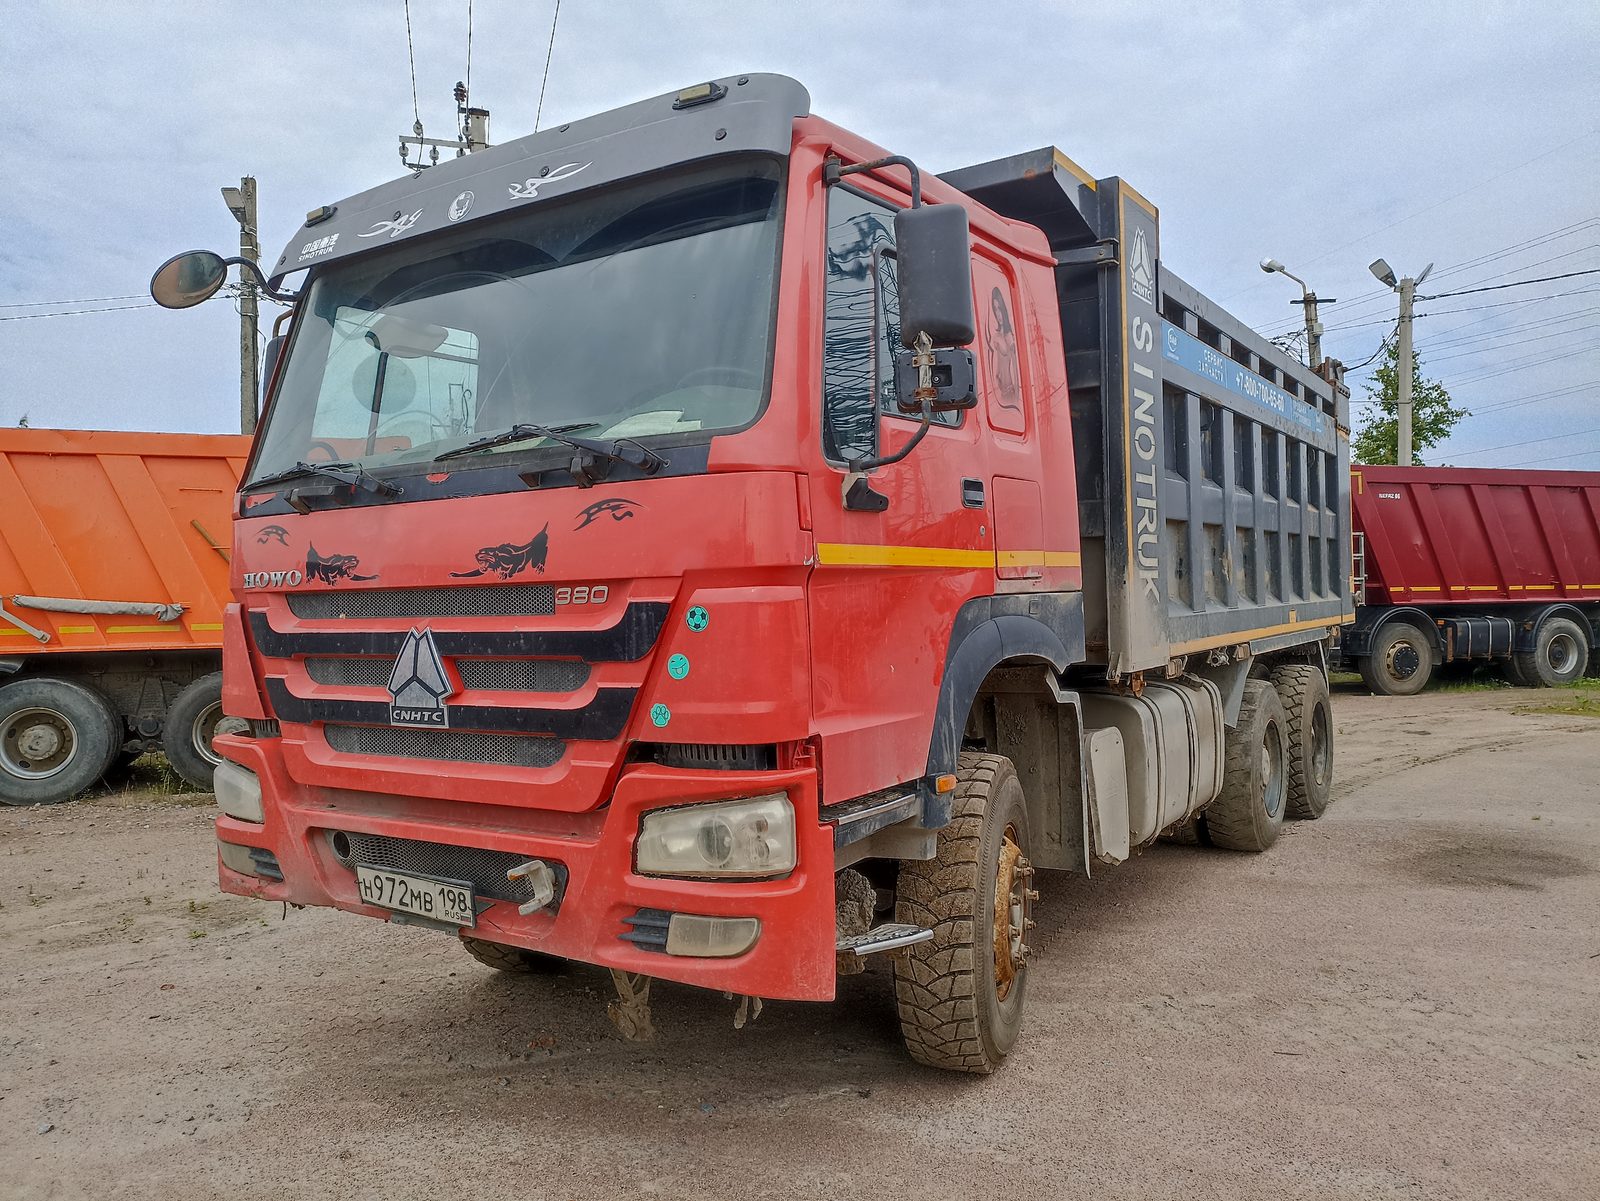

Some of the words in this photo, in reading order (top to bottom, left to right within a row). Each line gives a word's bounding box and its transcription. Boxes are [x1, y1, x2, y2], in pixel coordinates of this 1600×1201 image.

[298, 245, 334, 262] SINOTRUK
[1132, 282, 1152, 300] CNHTC
[1132, 316, 1160, 603] SINOTRUK
[243, 569, 302, 589] HOWO
[555, 585, 609, 605] 380
[392, 710, 443, 722] CNHTC
[438, 887, 467, 913] 198
[444, 909, 460, 920] RUS
